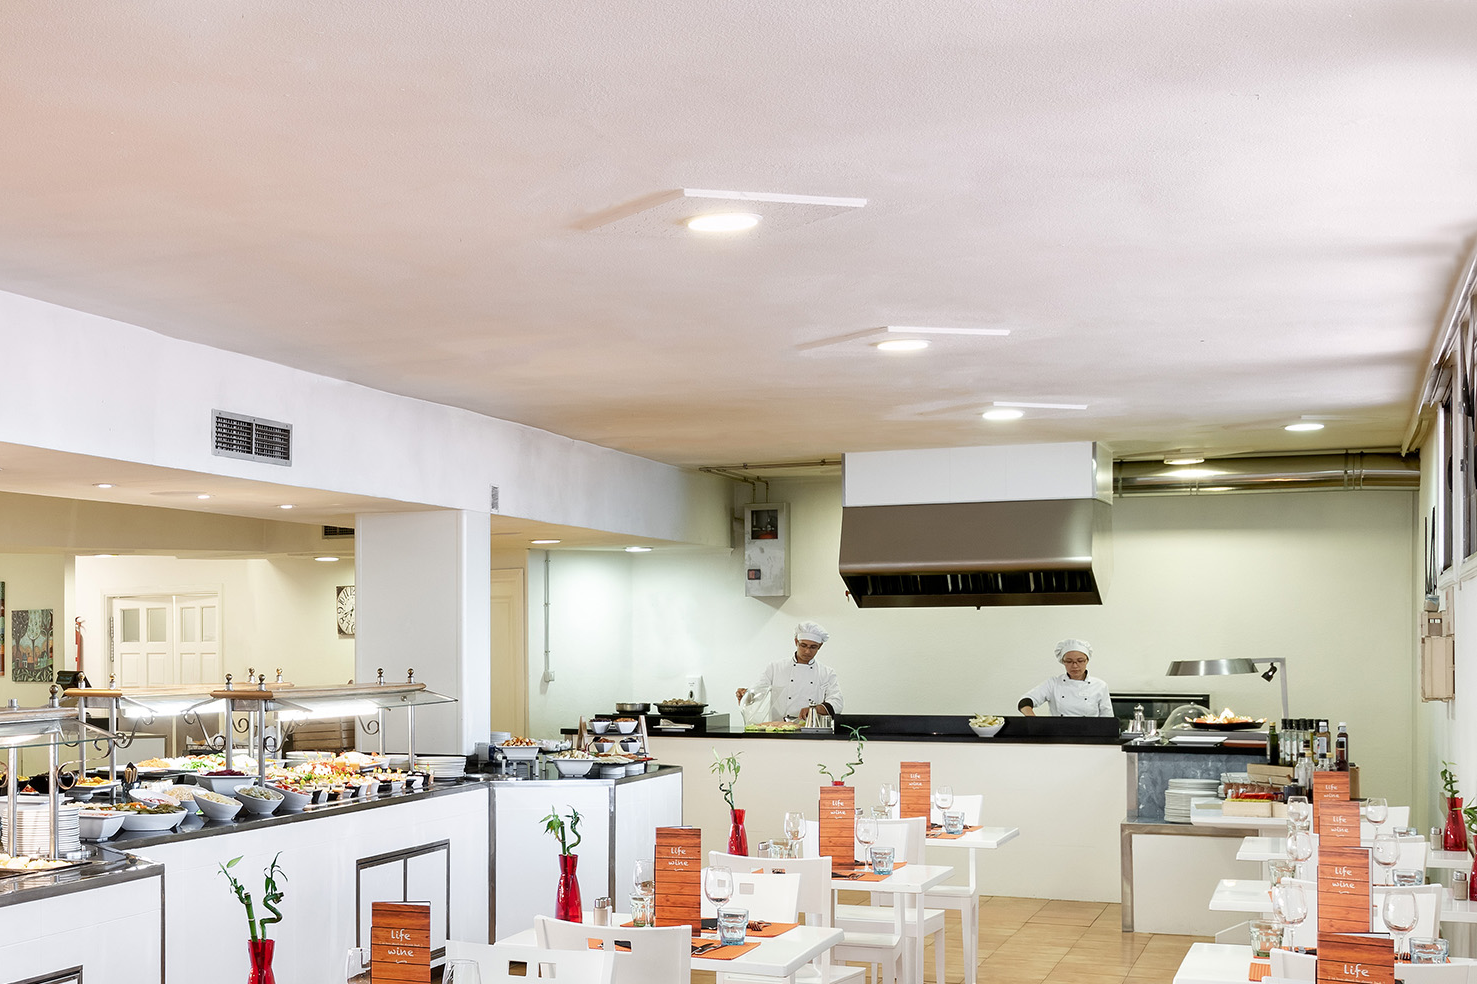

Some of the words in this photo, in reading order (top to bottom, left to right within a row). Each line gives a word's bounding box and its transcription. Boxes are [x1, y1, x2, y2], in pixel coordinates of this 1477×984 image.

[832, 799, 844, 807] life
[1332, 815, 1347, 823] life
[670, 846, 686, 855] life
[1334, 866, 1353, 877] life
[1331, 880, 1356, 889] wine
[391, 928, 411, 942] life
[387, 947, 414, 957] wine
[1344, 963, 1370, 978] life
